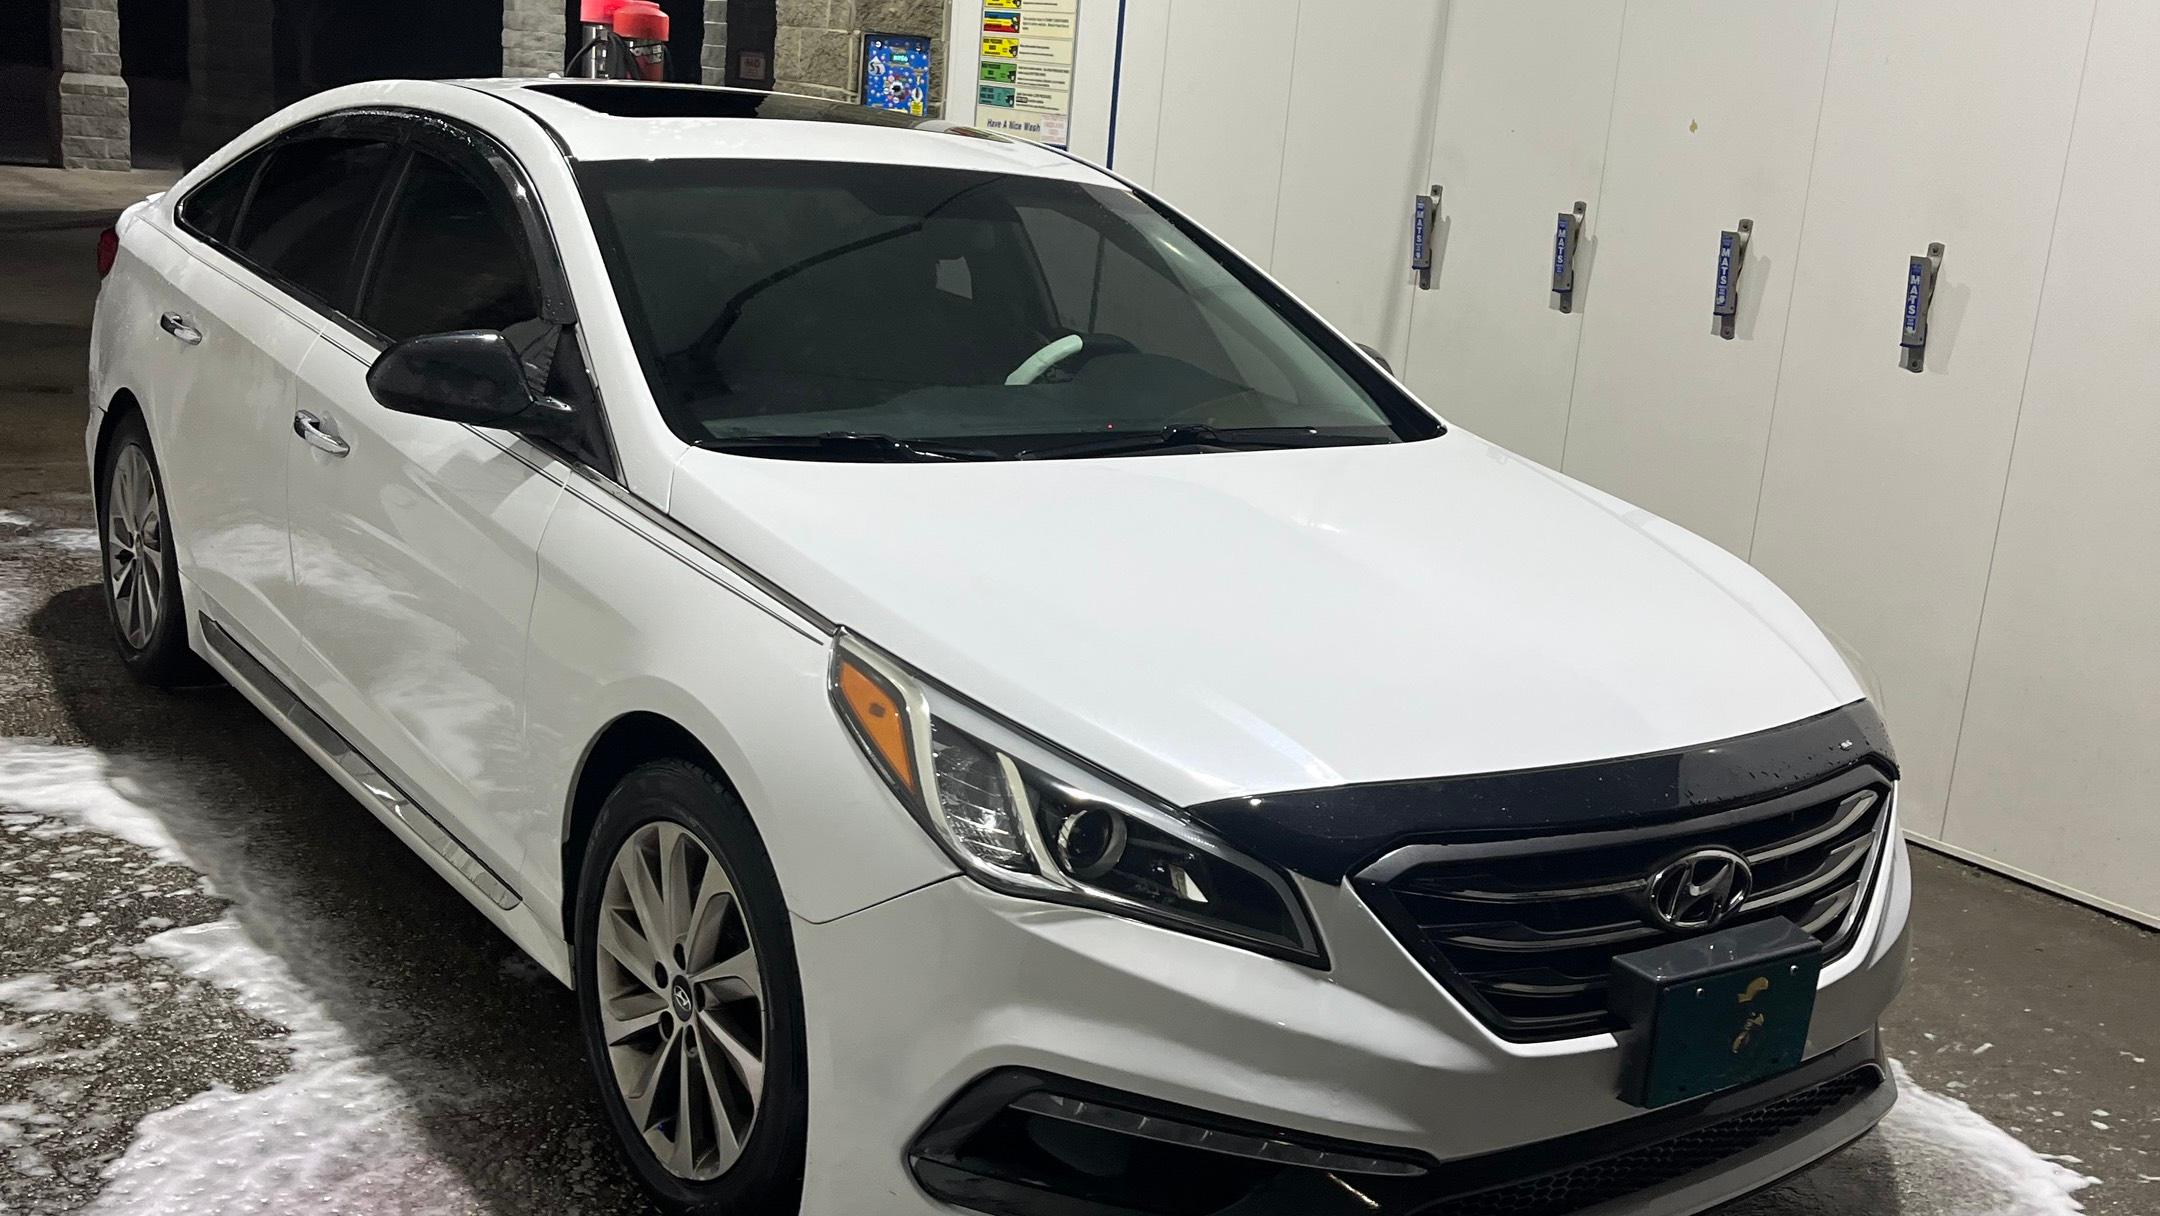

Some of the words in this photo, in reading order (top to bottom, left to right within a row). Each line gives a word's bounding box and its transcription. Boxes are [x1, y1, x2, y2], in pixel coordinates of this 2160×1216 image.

[987, 119, 1001, 128] Have
[1009, 121, 1021, 130] Nice
[1023, 122, 1041, 132] Wash
[1416, 210, 1424, 243] MATS
[1557, 229, 1566, 264] MATS
[1720, 247, 1731, 285] MATS
[1908, 274, 1920, 315] MATS
